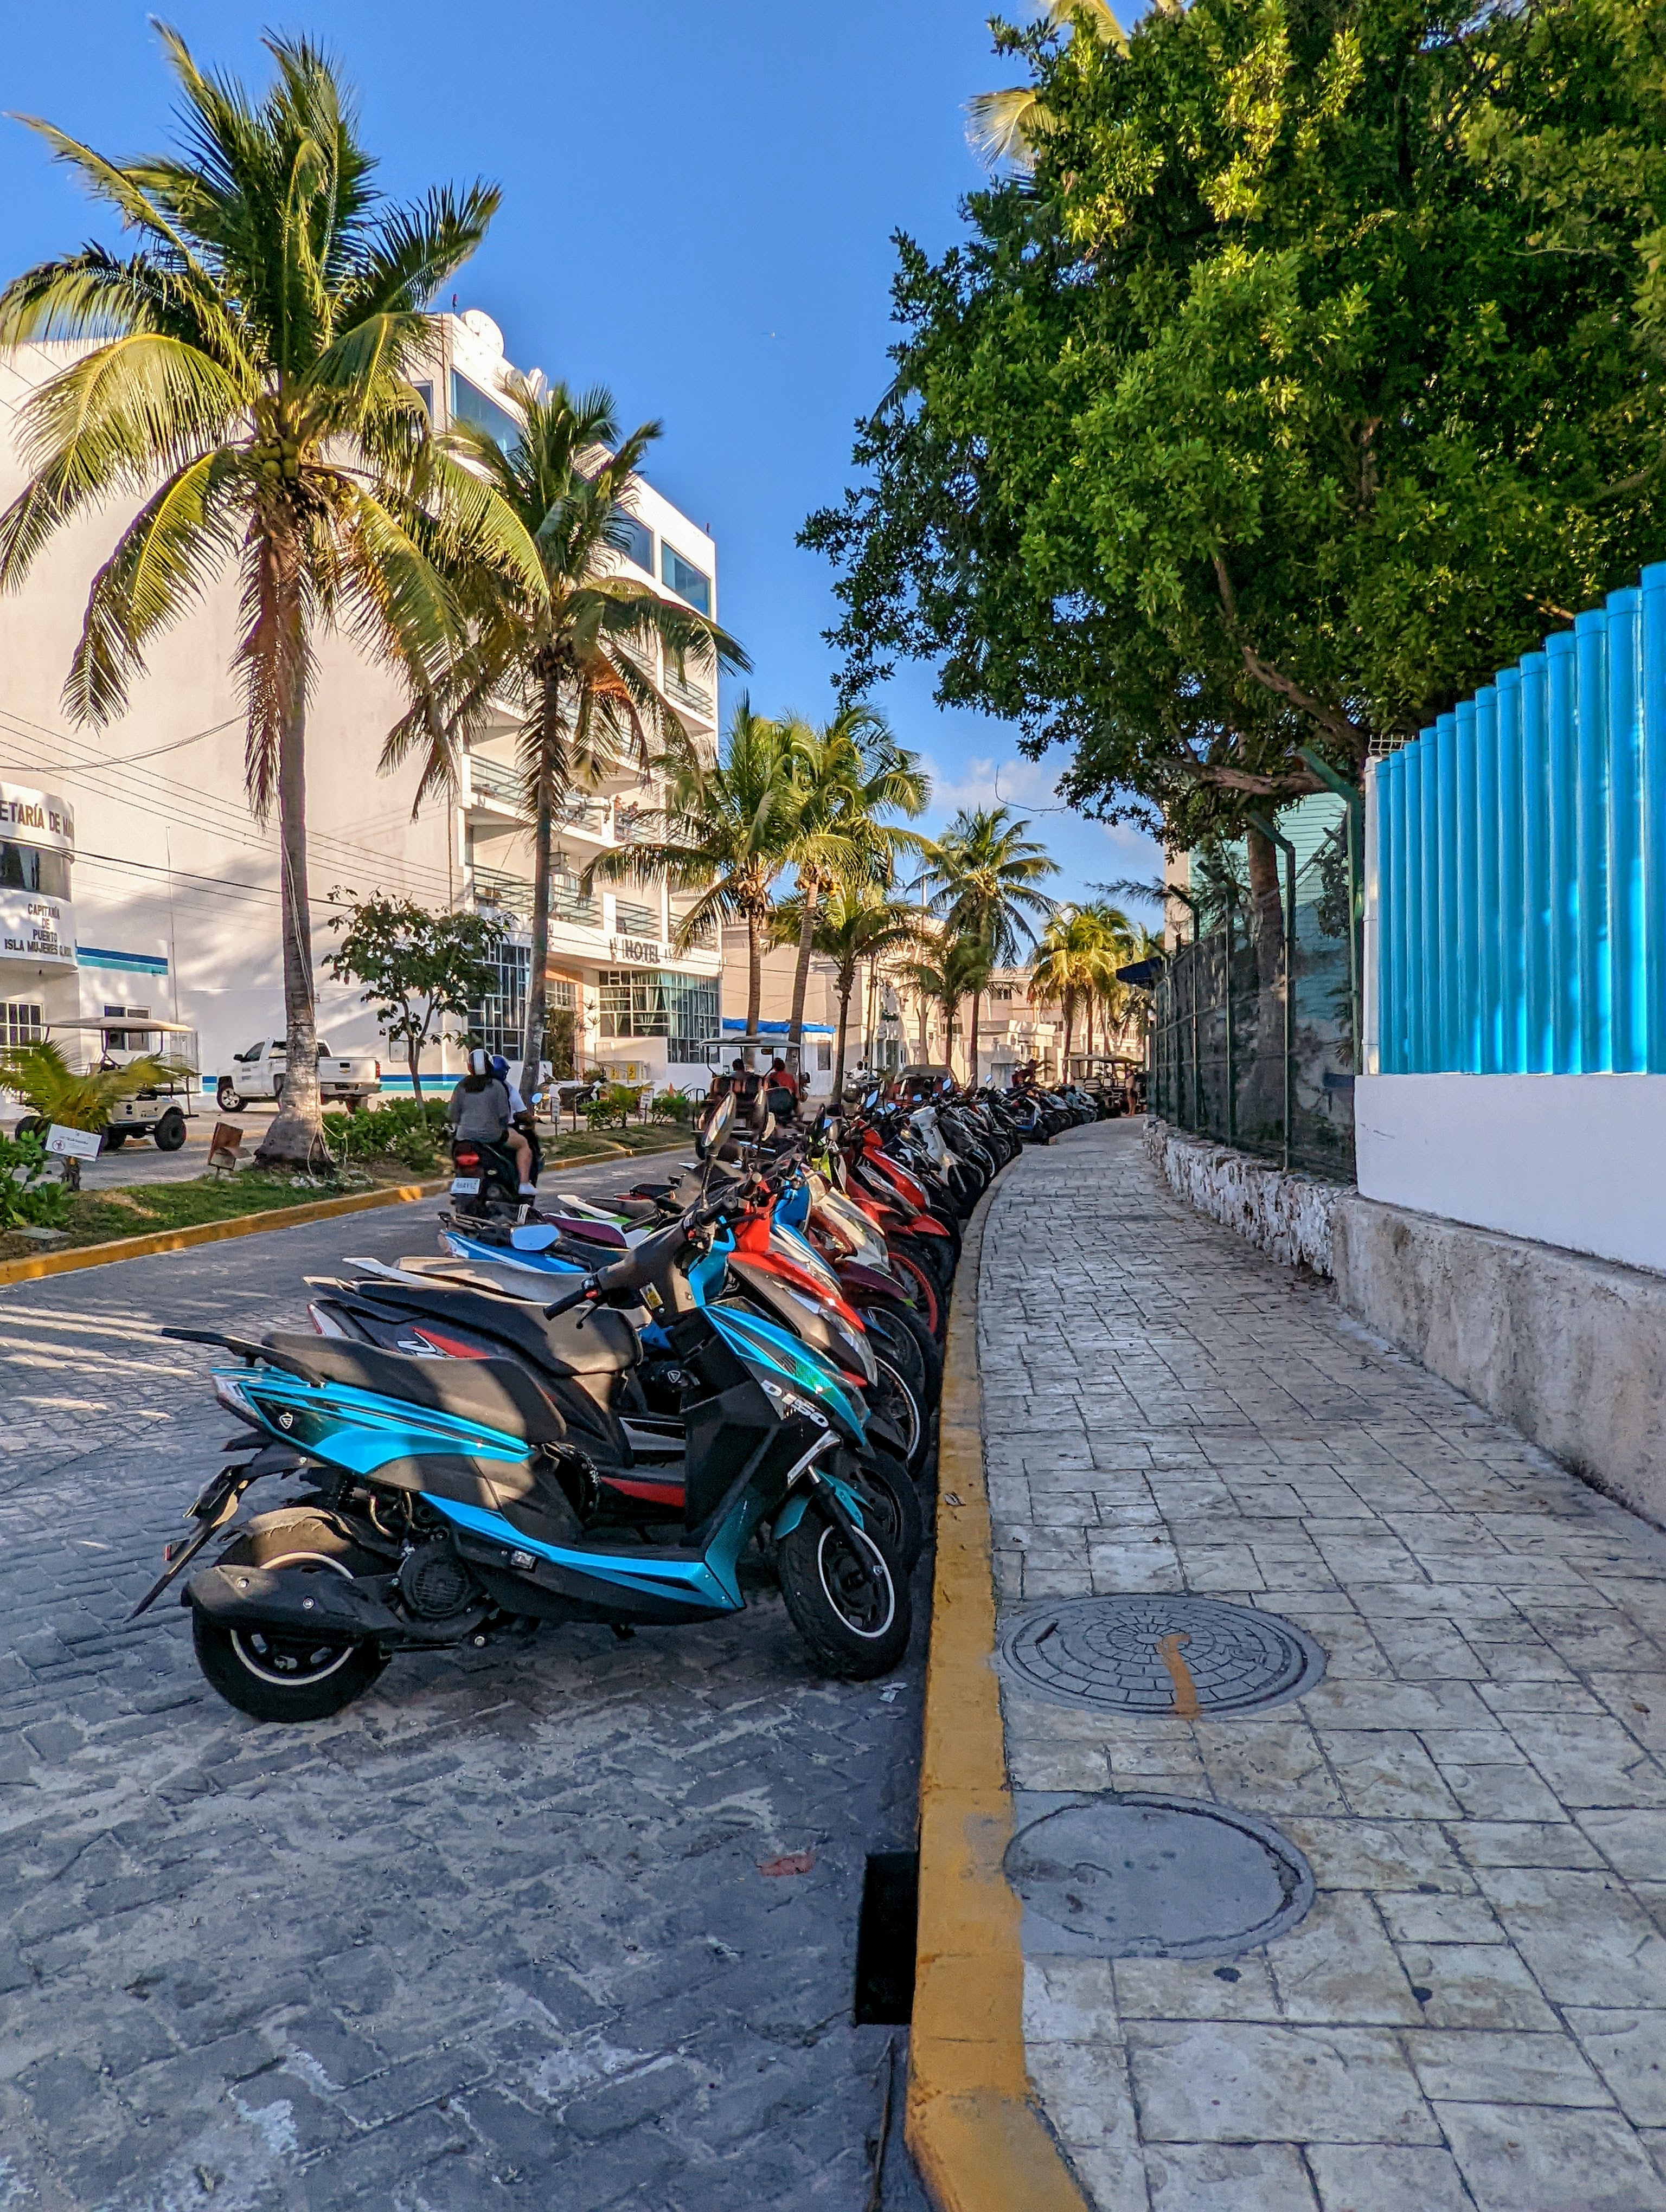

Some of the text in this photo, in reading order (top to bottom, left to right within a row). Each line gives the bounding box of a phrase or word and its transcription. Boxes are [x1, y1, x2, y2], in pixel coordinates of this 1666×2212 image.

[49, 810, 60, 834] DE
[42, 917, 50, 929] DE
[33, 929, 57, 942] PUERTO
[4, 938, 24, 951] ISLA
[621, 938, 661, 964] HOTEL
